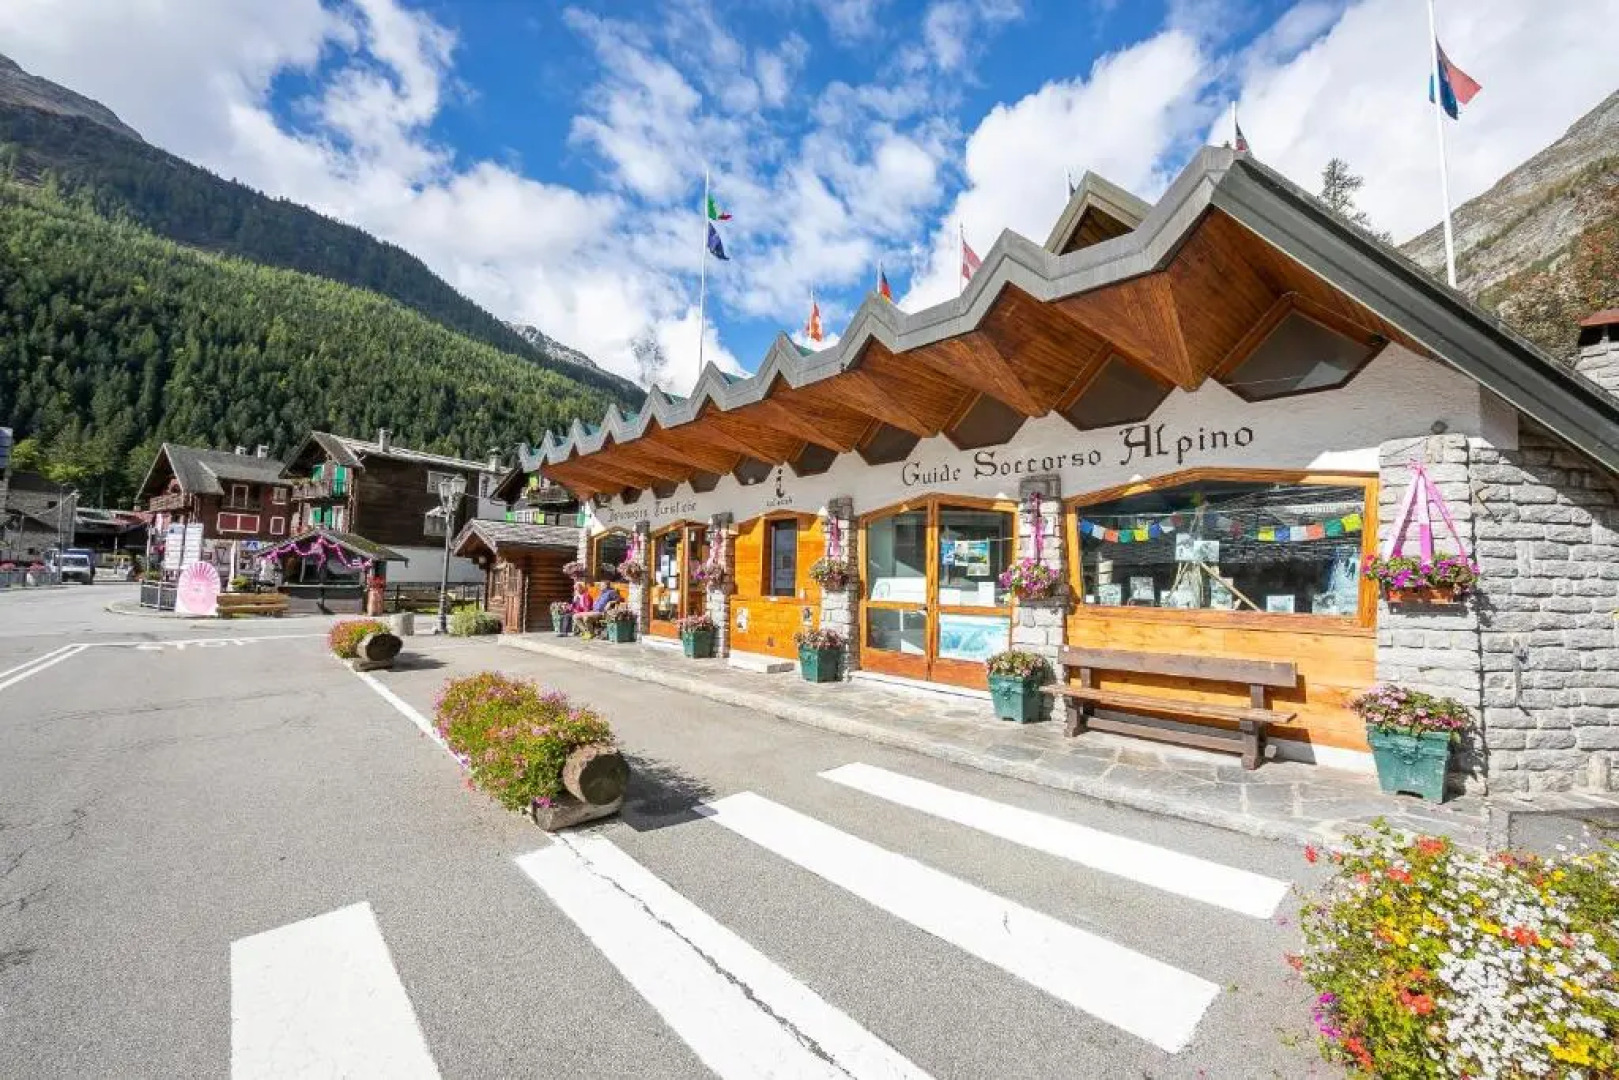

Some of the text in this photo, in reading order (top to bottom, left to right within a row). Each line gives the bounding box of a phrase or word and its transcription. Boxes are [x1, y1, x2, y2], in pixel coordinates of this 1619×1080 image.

[902, 423, 1254, 486] Guide Soccorso Alpino
